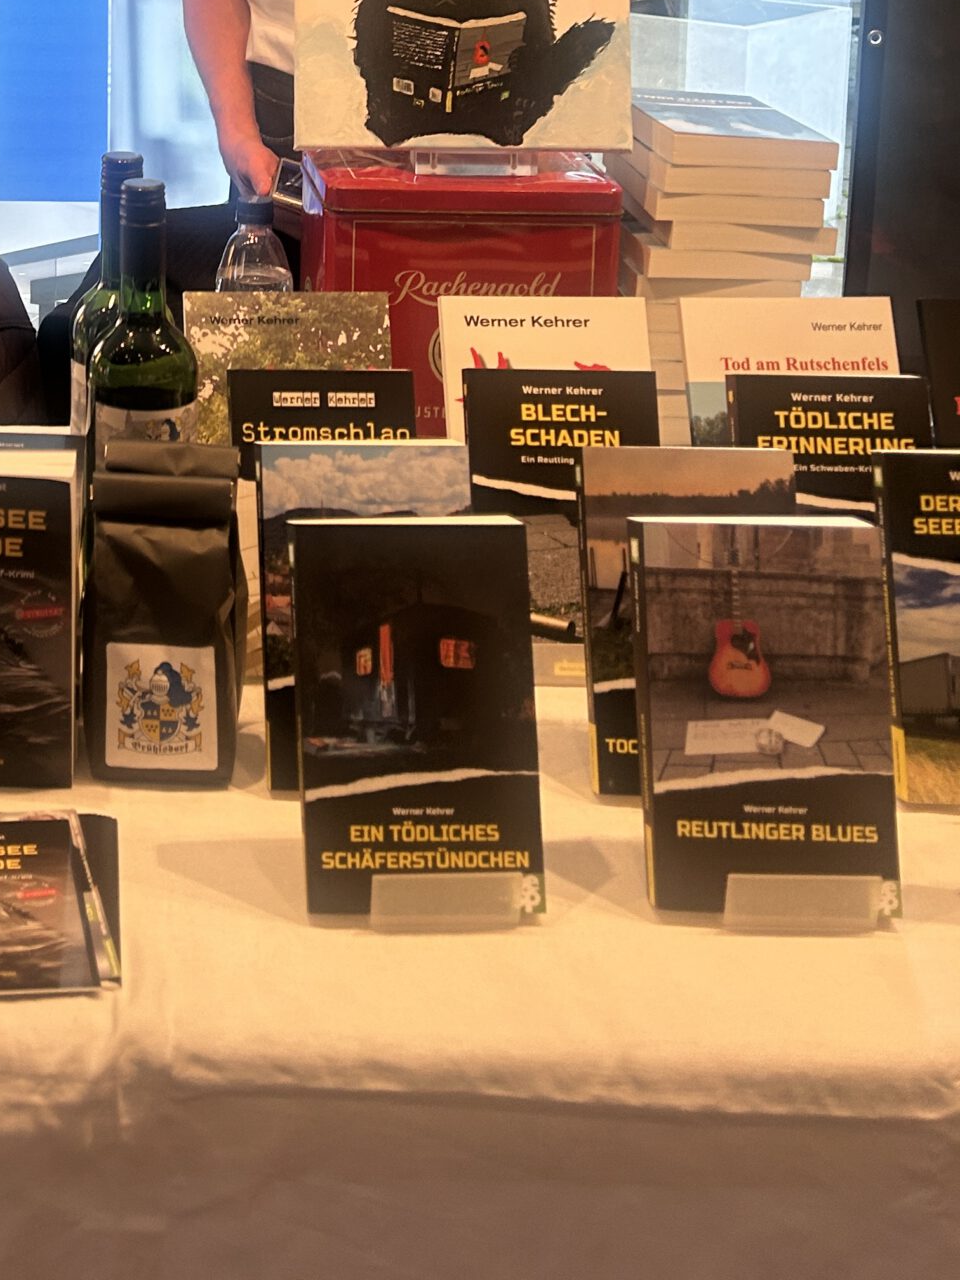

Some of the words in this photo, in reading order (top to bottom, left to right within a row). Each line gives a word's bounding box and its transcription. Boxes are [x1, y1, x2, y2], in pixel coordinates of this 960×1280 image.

[209, 315, 253, 325] Werner
[258, 315, 300, 325] Kehrer
[464, 316, 526, 327] Werner
[531, 316, 590, 328] Kehrer
[811, 322, 847, 332] Werner
[849, 322, 882, 331] Kehrer
[720, 357, 751, 371] Tod
[756, 360, 780, 371] am
[785, 357, 889, 371] Rutschenfels
[522, 385, 563, 395] Werner
[566, 386, 603, 396] Kehrer
[791, 392, 832, 402] Werner
[836, 392, 874, 403] Kehrer
[272, 392, 320, 407] Werner
[328, 392, 375, 408] Kehrer
[520, 404, 607, 422] BLECH-
[774, 406, 895, 430] TÖDLICHE
[510, 428, 620, 448] SCHADEN
[521, 455, 535, 464] Ein
[350, 825, 384, 842] EIN
[389, 821, 499, 842] TÖDLICHES
[677, 820, 805, 841] REUTLINGER
[811, 822, 878, 843] BLUES
[321, 847, 529, 870] SCHÄFERSTÜNDCHEN
